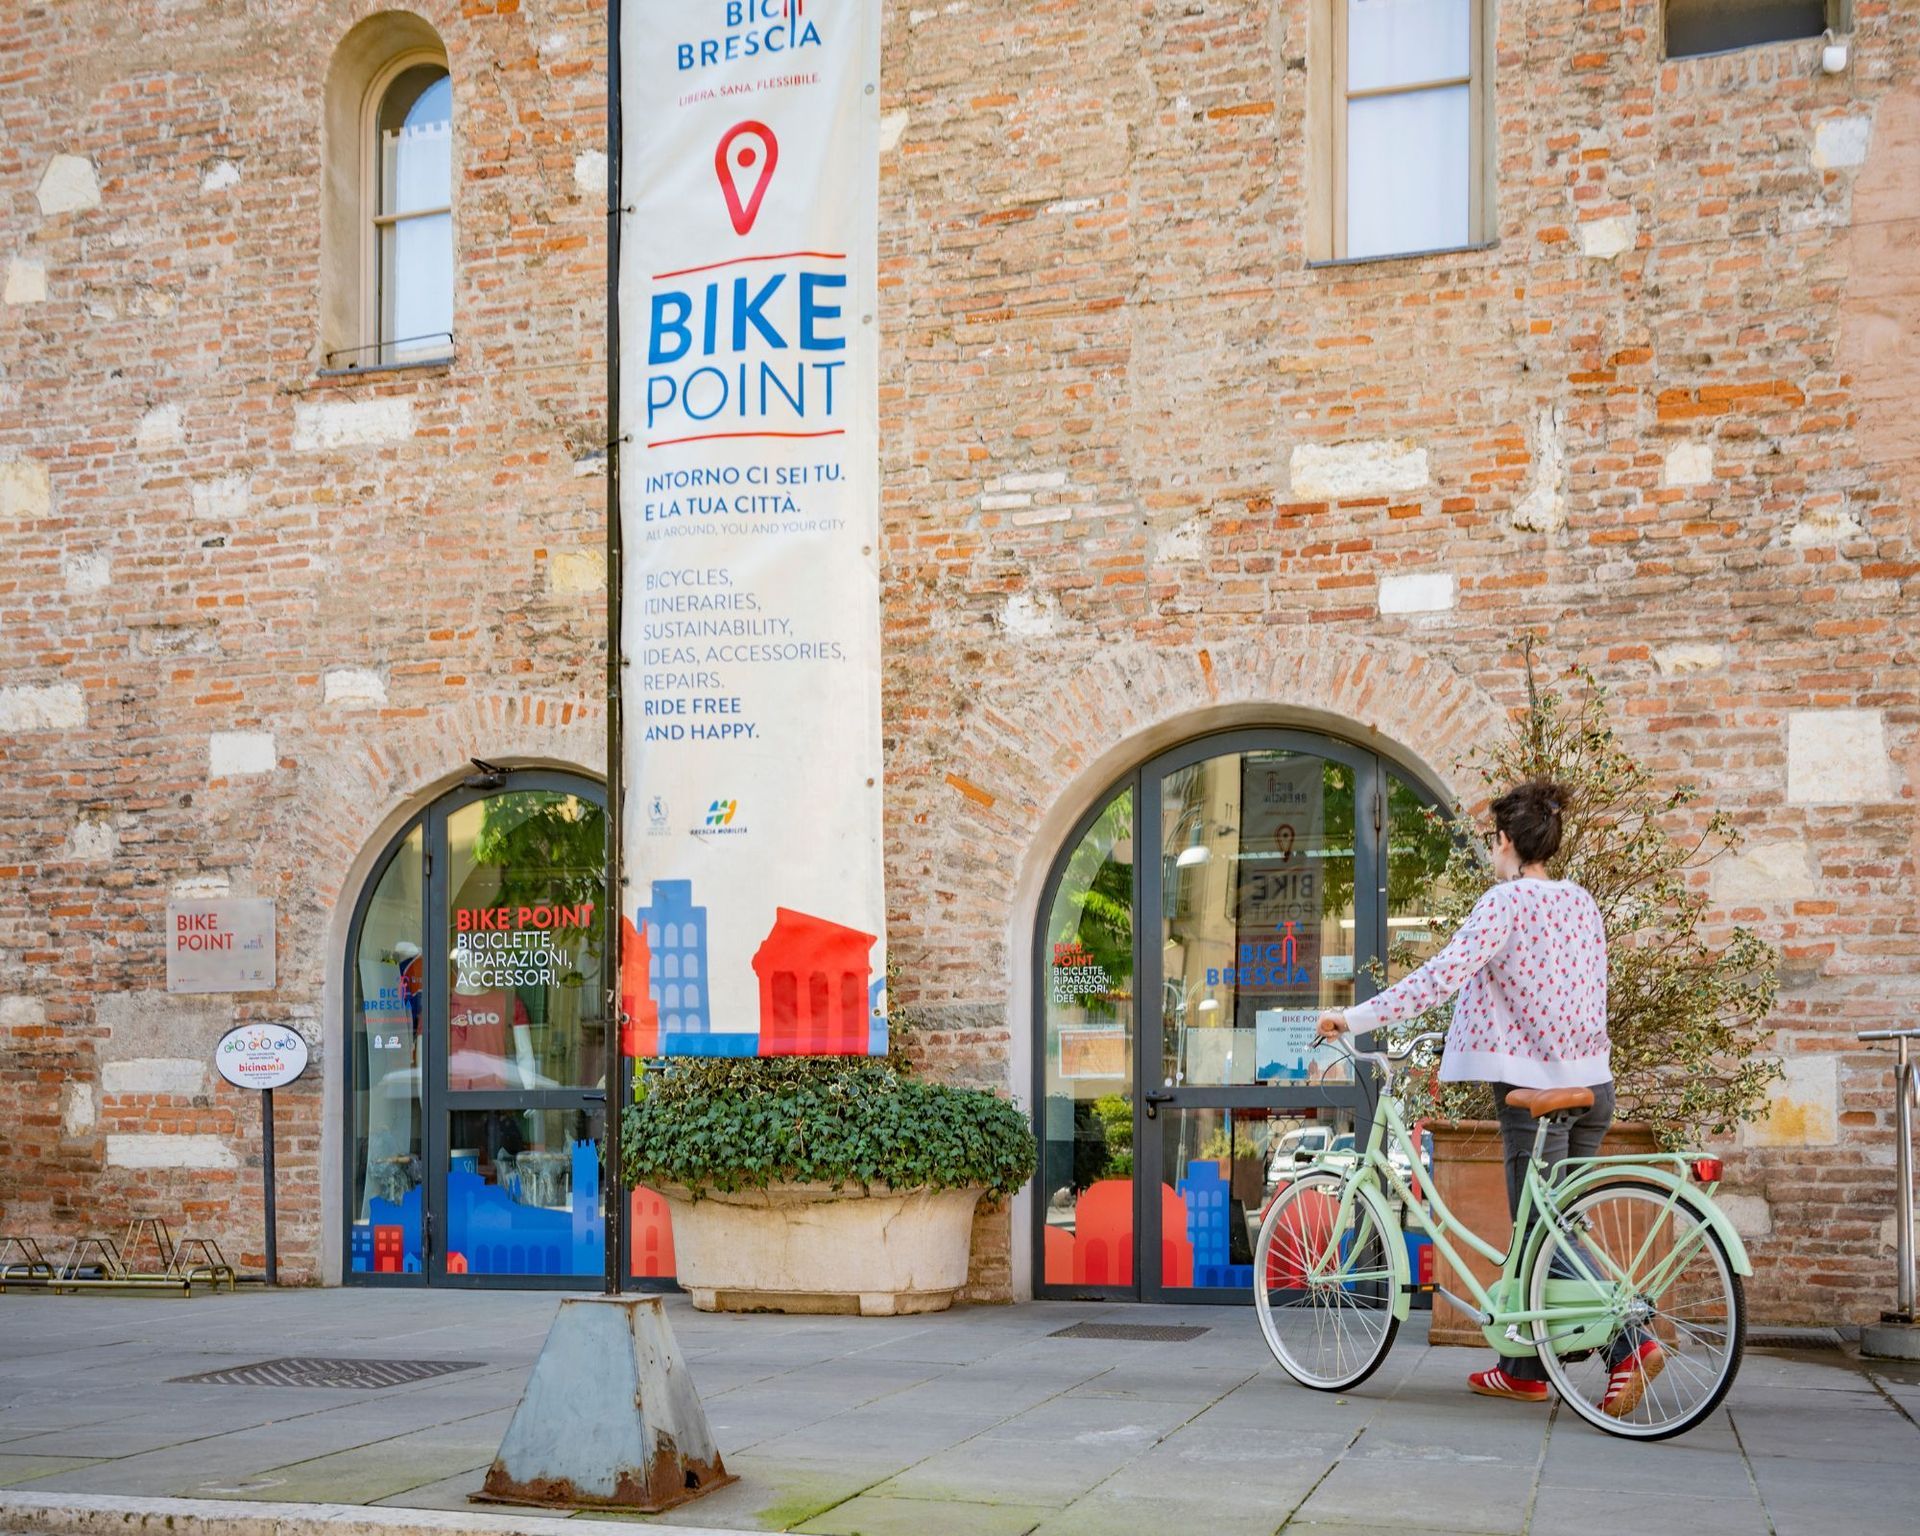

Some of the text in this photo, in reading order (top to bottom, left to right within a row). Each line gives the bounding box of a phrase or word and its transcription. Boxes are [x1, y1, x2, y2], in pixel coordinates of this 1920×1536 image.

[678, 20, 822, 71] BRESCIA
[648, 272, 847, 365] BIKE
[647, 361, 845, 429] POINT
[646, 464, 845, 493] INTORNO CI SEI TU.
[645, 491, 801, 521] E LA TUA CITTÀ.
[664, 522, 719, 538] AROUND,
[721, 523, 748, 535] YOU
[752, 522, 779, 535] AND
[782, 519, 816, 533] YOUR
[819, 519, 846, 532] CITY
[646, 569, 733, 591] BICYCLES,
[644, 593, 761, 615] ITINERARIES,
[643, 618, 793, 641] SUSTAINABILITY,
[643, 642, 847, 666] IDEAS, ACCESSORIES,
[643, 672, 725, 691] REPAIRS.
[645, 698, 741, 716] RIDE FREE
[645, 723, 760, 741] AND HAPPY.
[177, 913, 218, 932] BIKE
[456, 903, 596, 931] BIKE POINT
[177, 933, 234, 952] POINT
[457, 931, 555, 950] BICICLETTE,
[1054, 943, 1083, 954] BIKE
[456, 949, 573, 969] RIPARAZIONI,
[1053, 955, 1094, 967] POINT
[456, 969, 560, 989] ACCESSORI,
[1053, 966, 1106, 976] BICICLETTE,
[1053, 975, 1115, 985] RIPARAZIONI,
[1206, 965, 1310, 986] BRESCIA
[1053, 984, 1109, 994] ACCESSORI,
[363, 999, 411, 1011] BRESCIA
[1053, 994, 1077, 1004] IDEE,
[1282, 1015, 1319, 1023] BIKE POI
